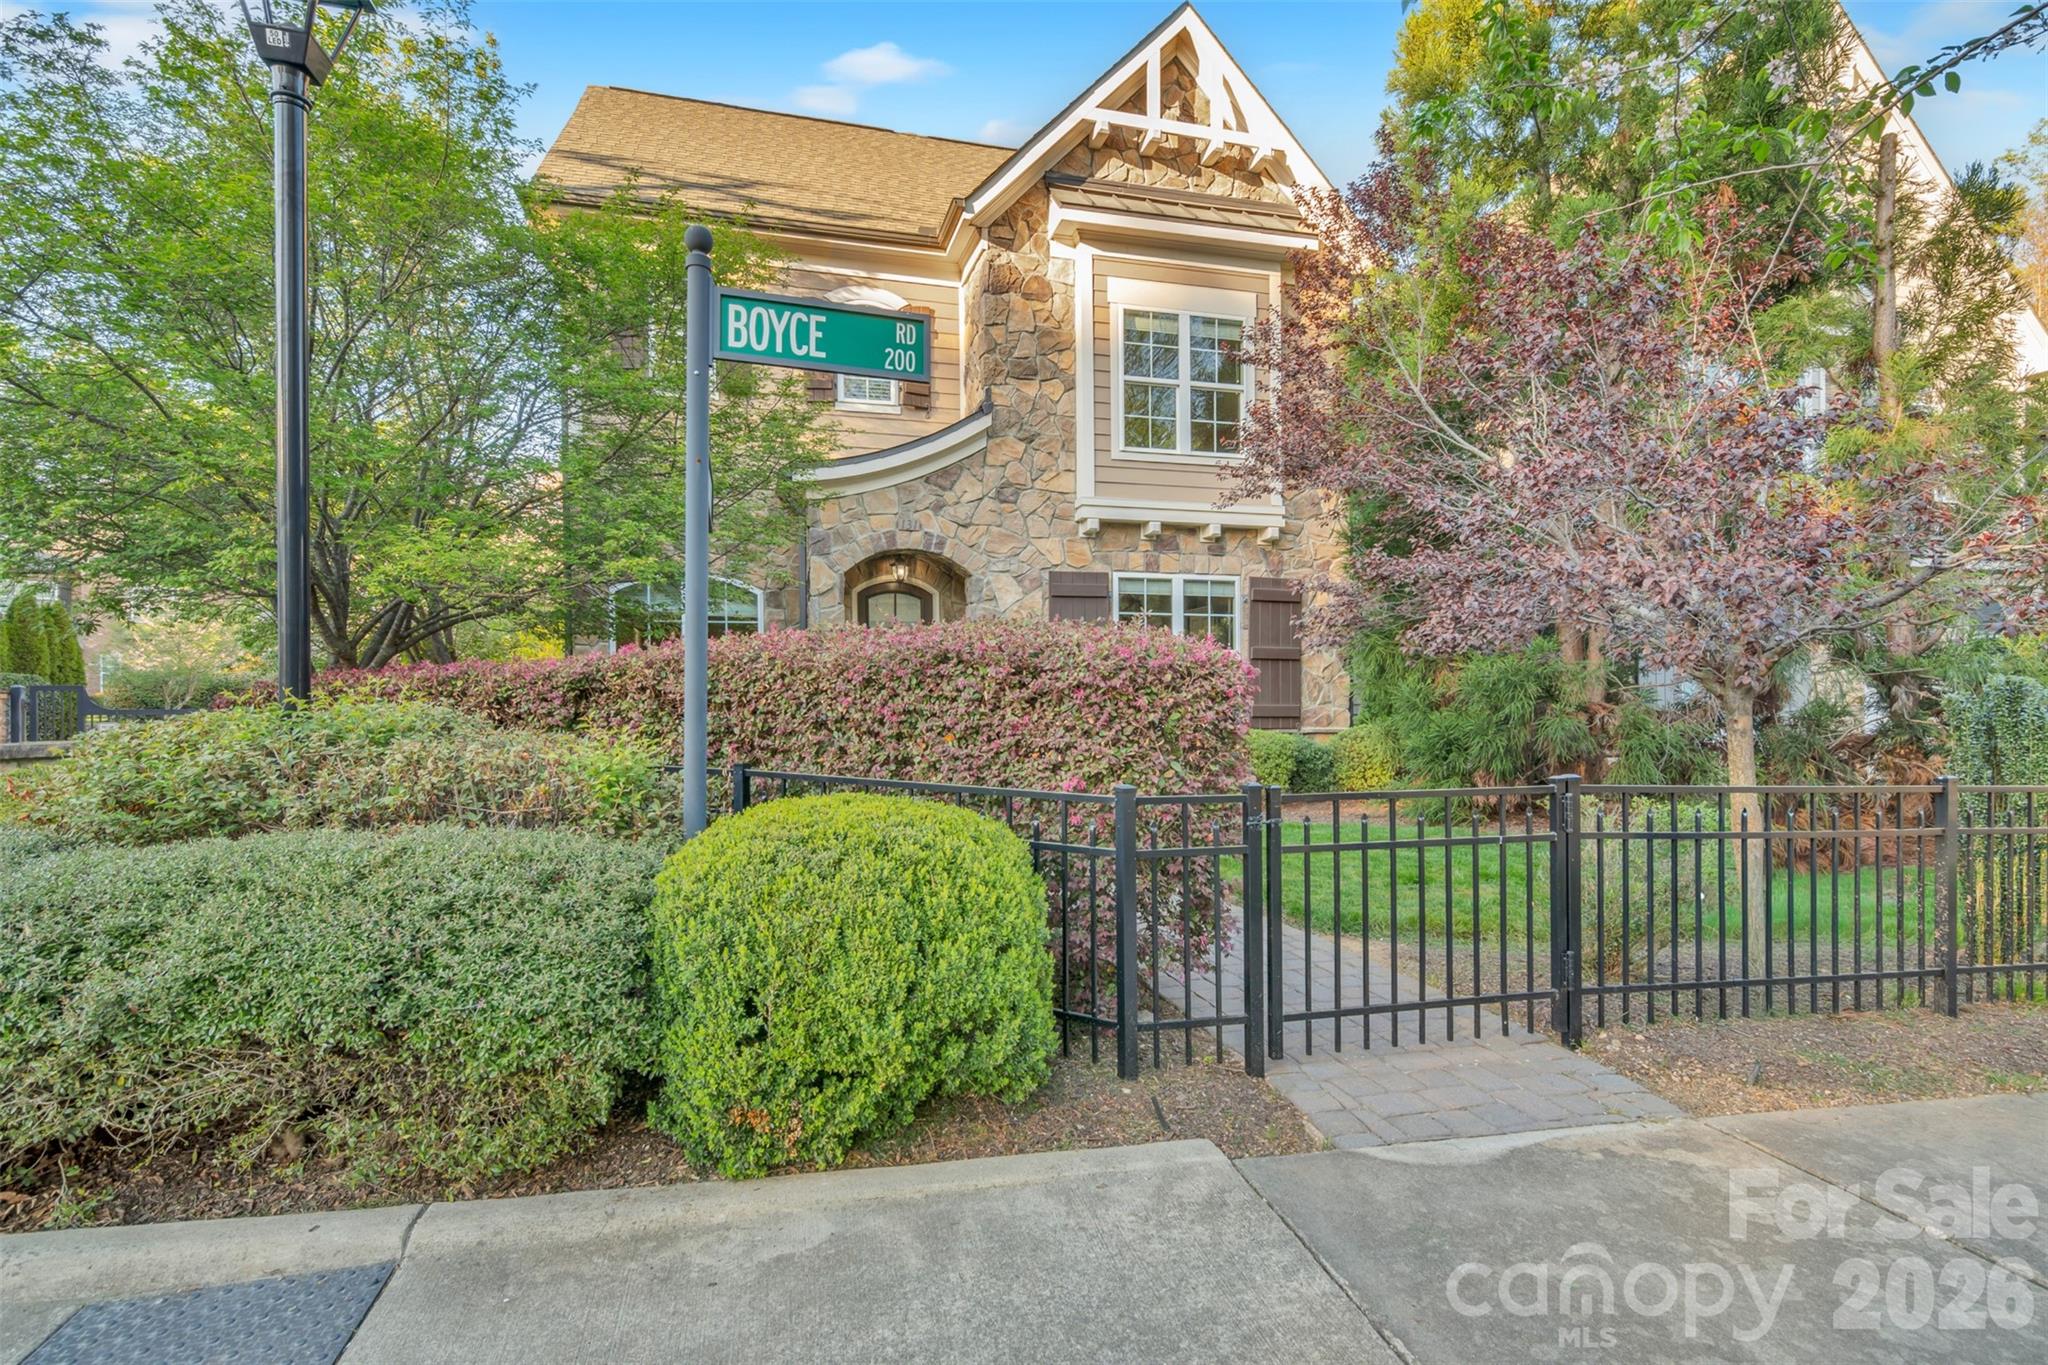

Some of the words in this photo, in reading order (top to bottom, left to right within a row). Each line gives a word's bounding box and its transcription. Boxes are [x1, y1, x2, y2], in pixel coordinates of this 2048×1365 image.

[268, 37, 282, 45] LED
[728, 303, 826, 358] BOYCE
[895, 323, 916, 346] RD
[884, 348, 916, 373] 200
